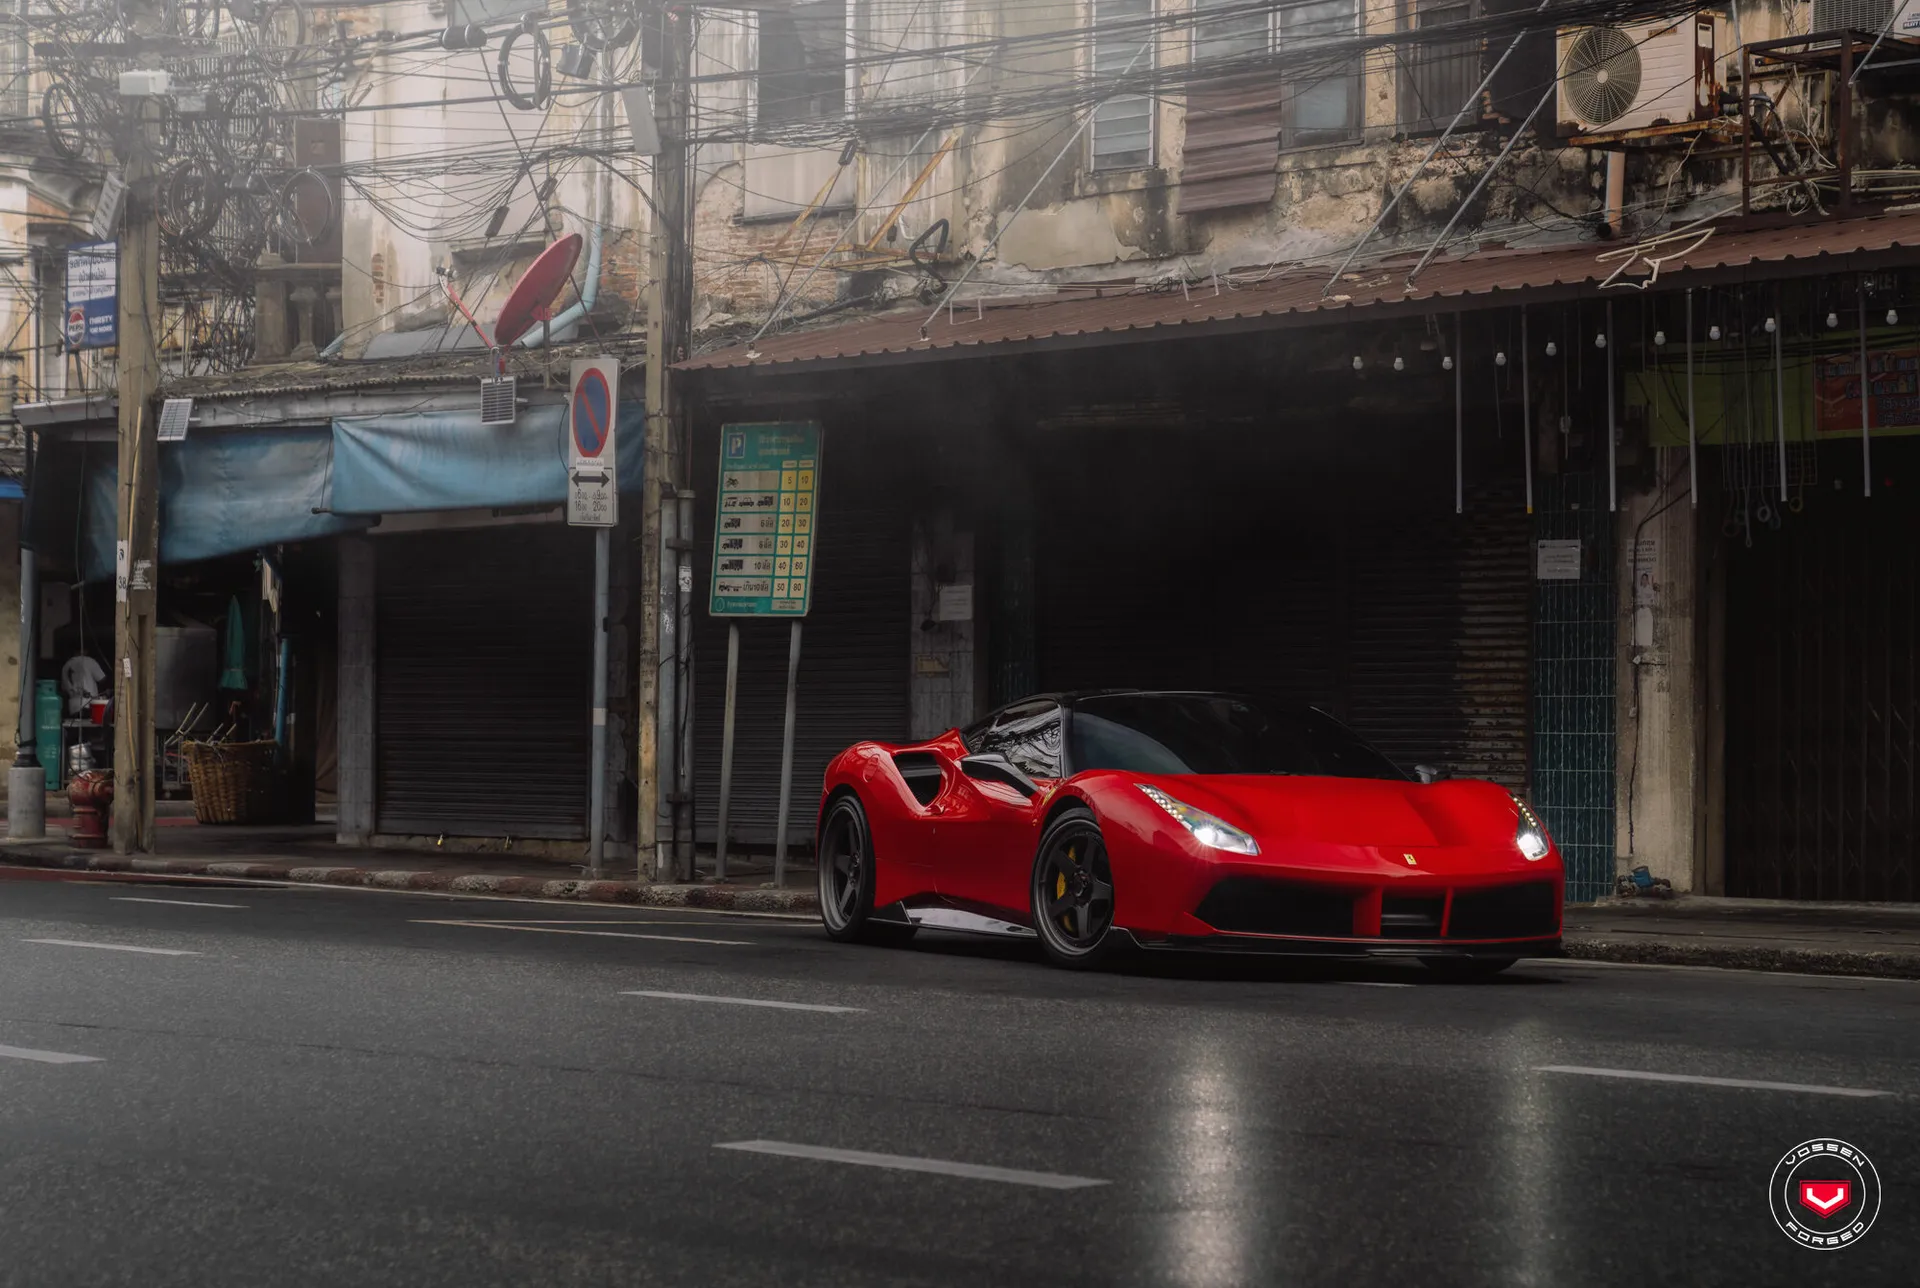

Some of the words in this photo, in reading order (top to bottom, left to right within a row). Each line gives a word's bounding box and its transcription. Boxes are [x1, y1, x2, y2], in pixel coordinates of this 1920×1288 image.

[89, 315, 113, 325] THIRSTY
[69, 323, 84, 333] PEPSI
[801, 475, 809, 485] 10
[783, 497, 791, 506] 10
[799, 497, 808, 506] 20
[781, 519, 790, 528] 20
[798, 519, 807, 528] 30
[779, 540, 789, 549] 30
[796, 540, 805, 549] 40
[778, 562, 787, 570] 40
[776, 583, 785, 592] 50
